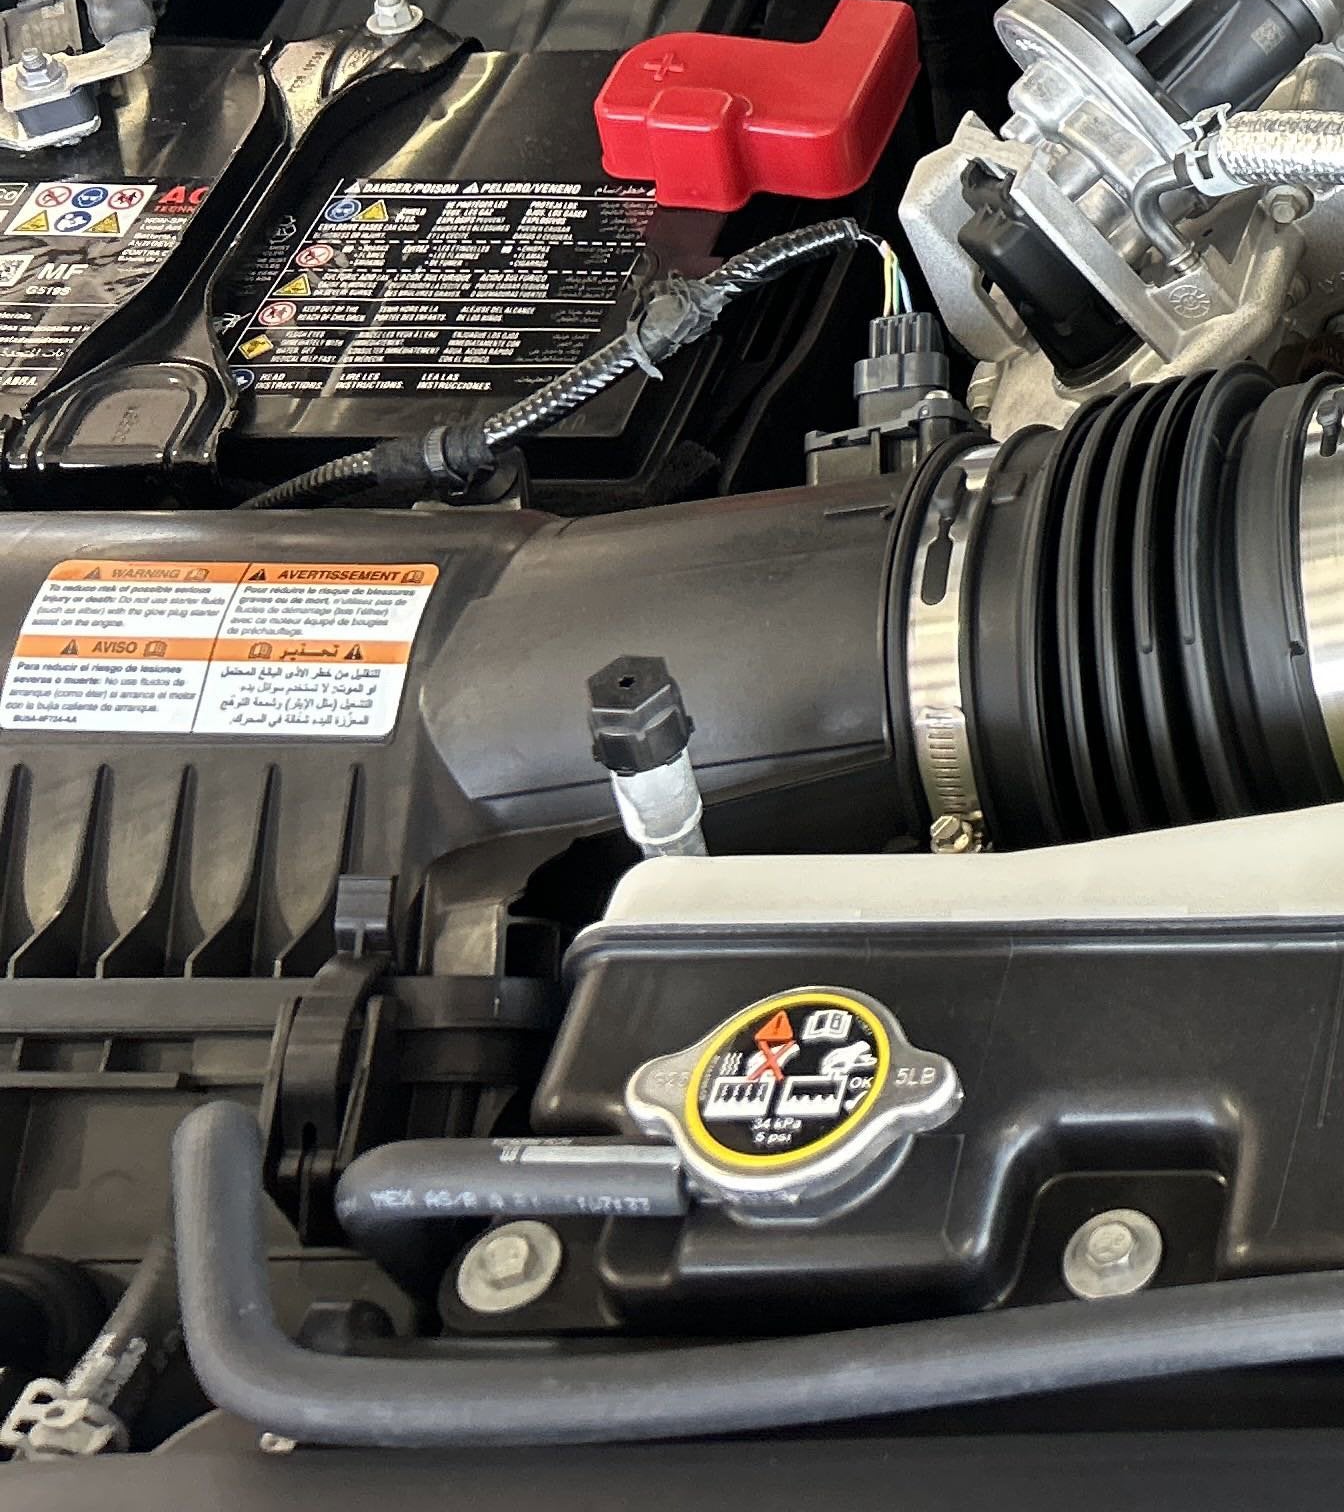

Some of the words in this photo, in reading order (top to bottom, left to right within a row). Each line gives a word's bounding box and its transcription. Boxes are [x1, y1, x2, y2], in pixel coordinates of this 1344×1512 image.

[362, 183, 459, 193] DANGER/POISON
[480, 182, 581, 194] PELIGRO/VENENO
[37, 263, 89, 280] MF
[111, 569, 181, 579] WARNING
[277, 570, 401, 581] AVERTISSEMENT
[91, 641, 138, 654] AVISO
